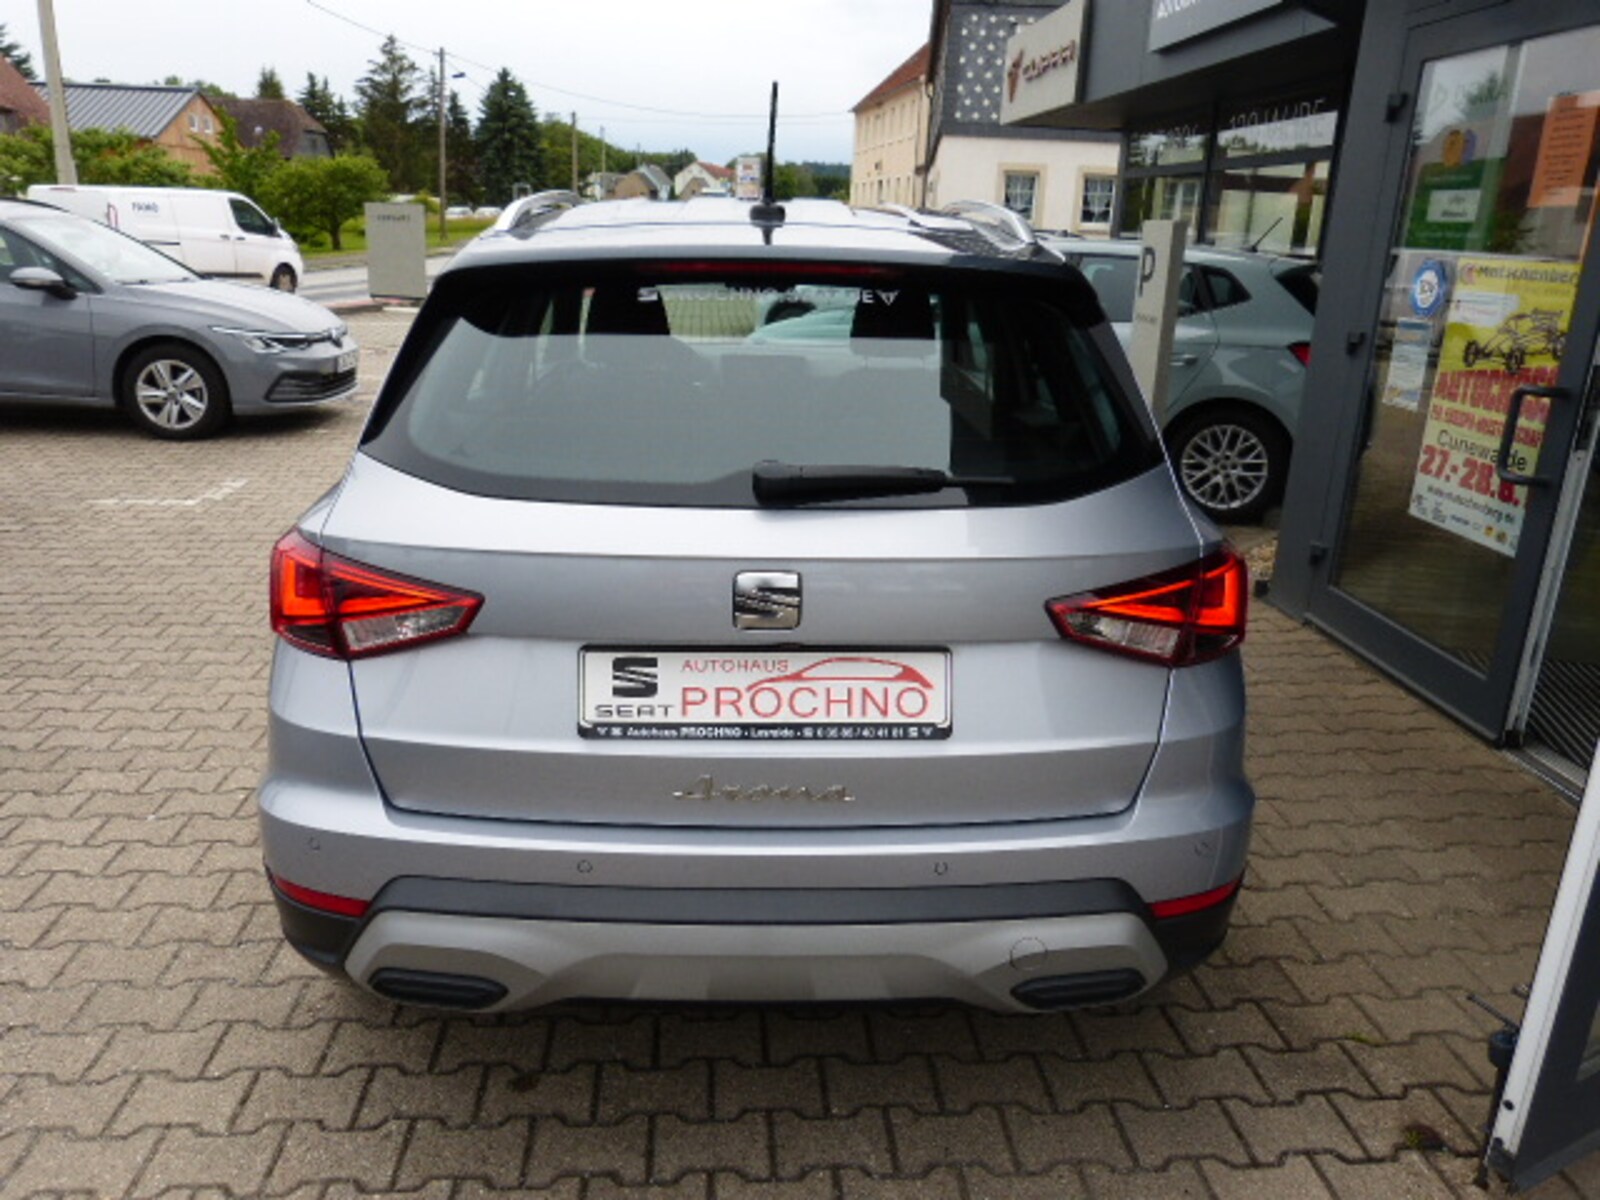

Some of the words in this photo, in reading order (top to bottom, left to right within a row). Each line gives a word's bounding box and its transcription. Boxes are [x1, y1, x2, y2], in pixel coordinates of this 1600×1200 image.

[1437, 429, 1527, 472] Cunewade
[682, 658, 789, 673] AUTOHAUS
[594, 704, 675, 718] SEAT
[681, 687, 928, 718] PROCHNO
